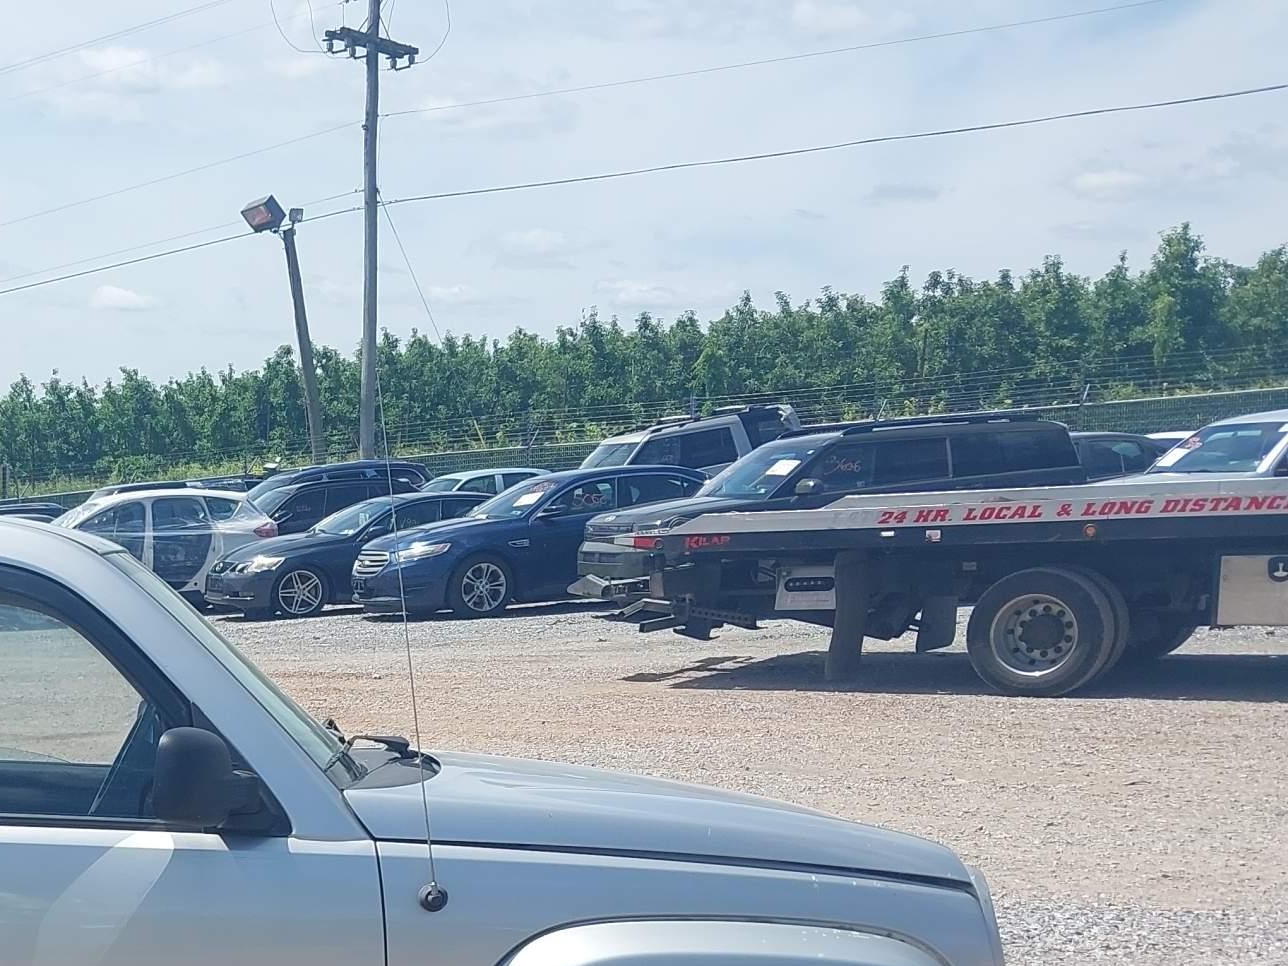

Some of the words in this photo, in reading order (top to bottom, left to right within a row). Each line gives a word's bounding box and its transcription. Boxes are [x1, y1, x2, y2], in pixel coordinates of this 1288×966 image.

[878, 509, 908, 524] 24
[913, 508, 952, 523] HR.
[962, 504, 1042, 521] LOCAL
[1056, 503, 1073, 517] &
[1080, 500, 1154, 517] LONG
[1160, 495, 1288, 514] DISTANC
